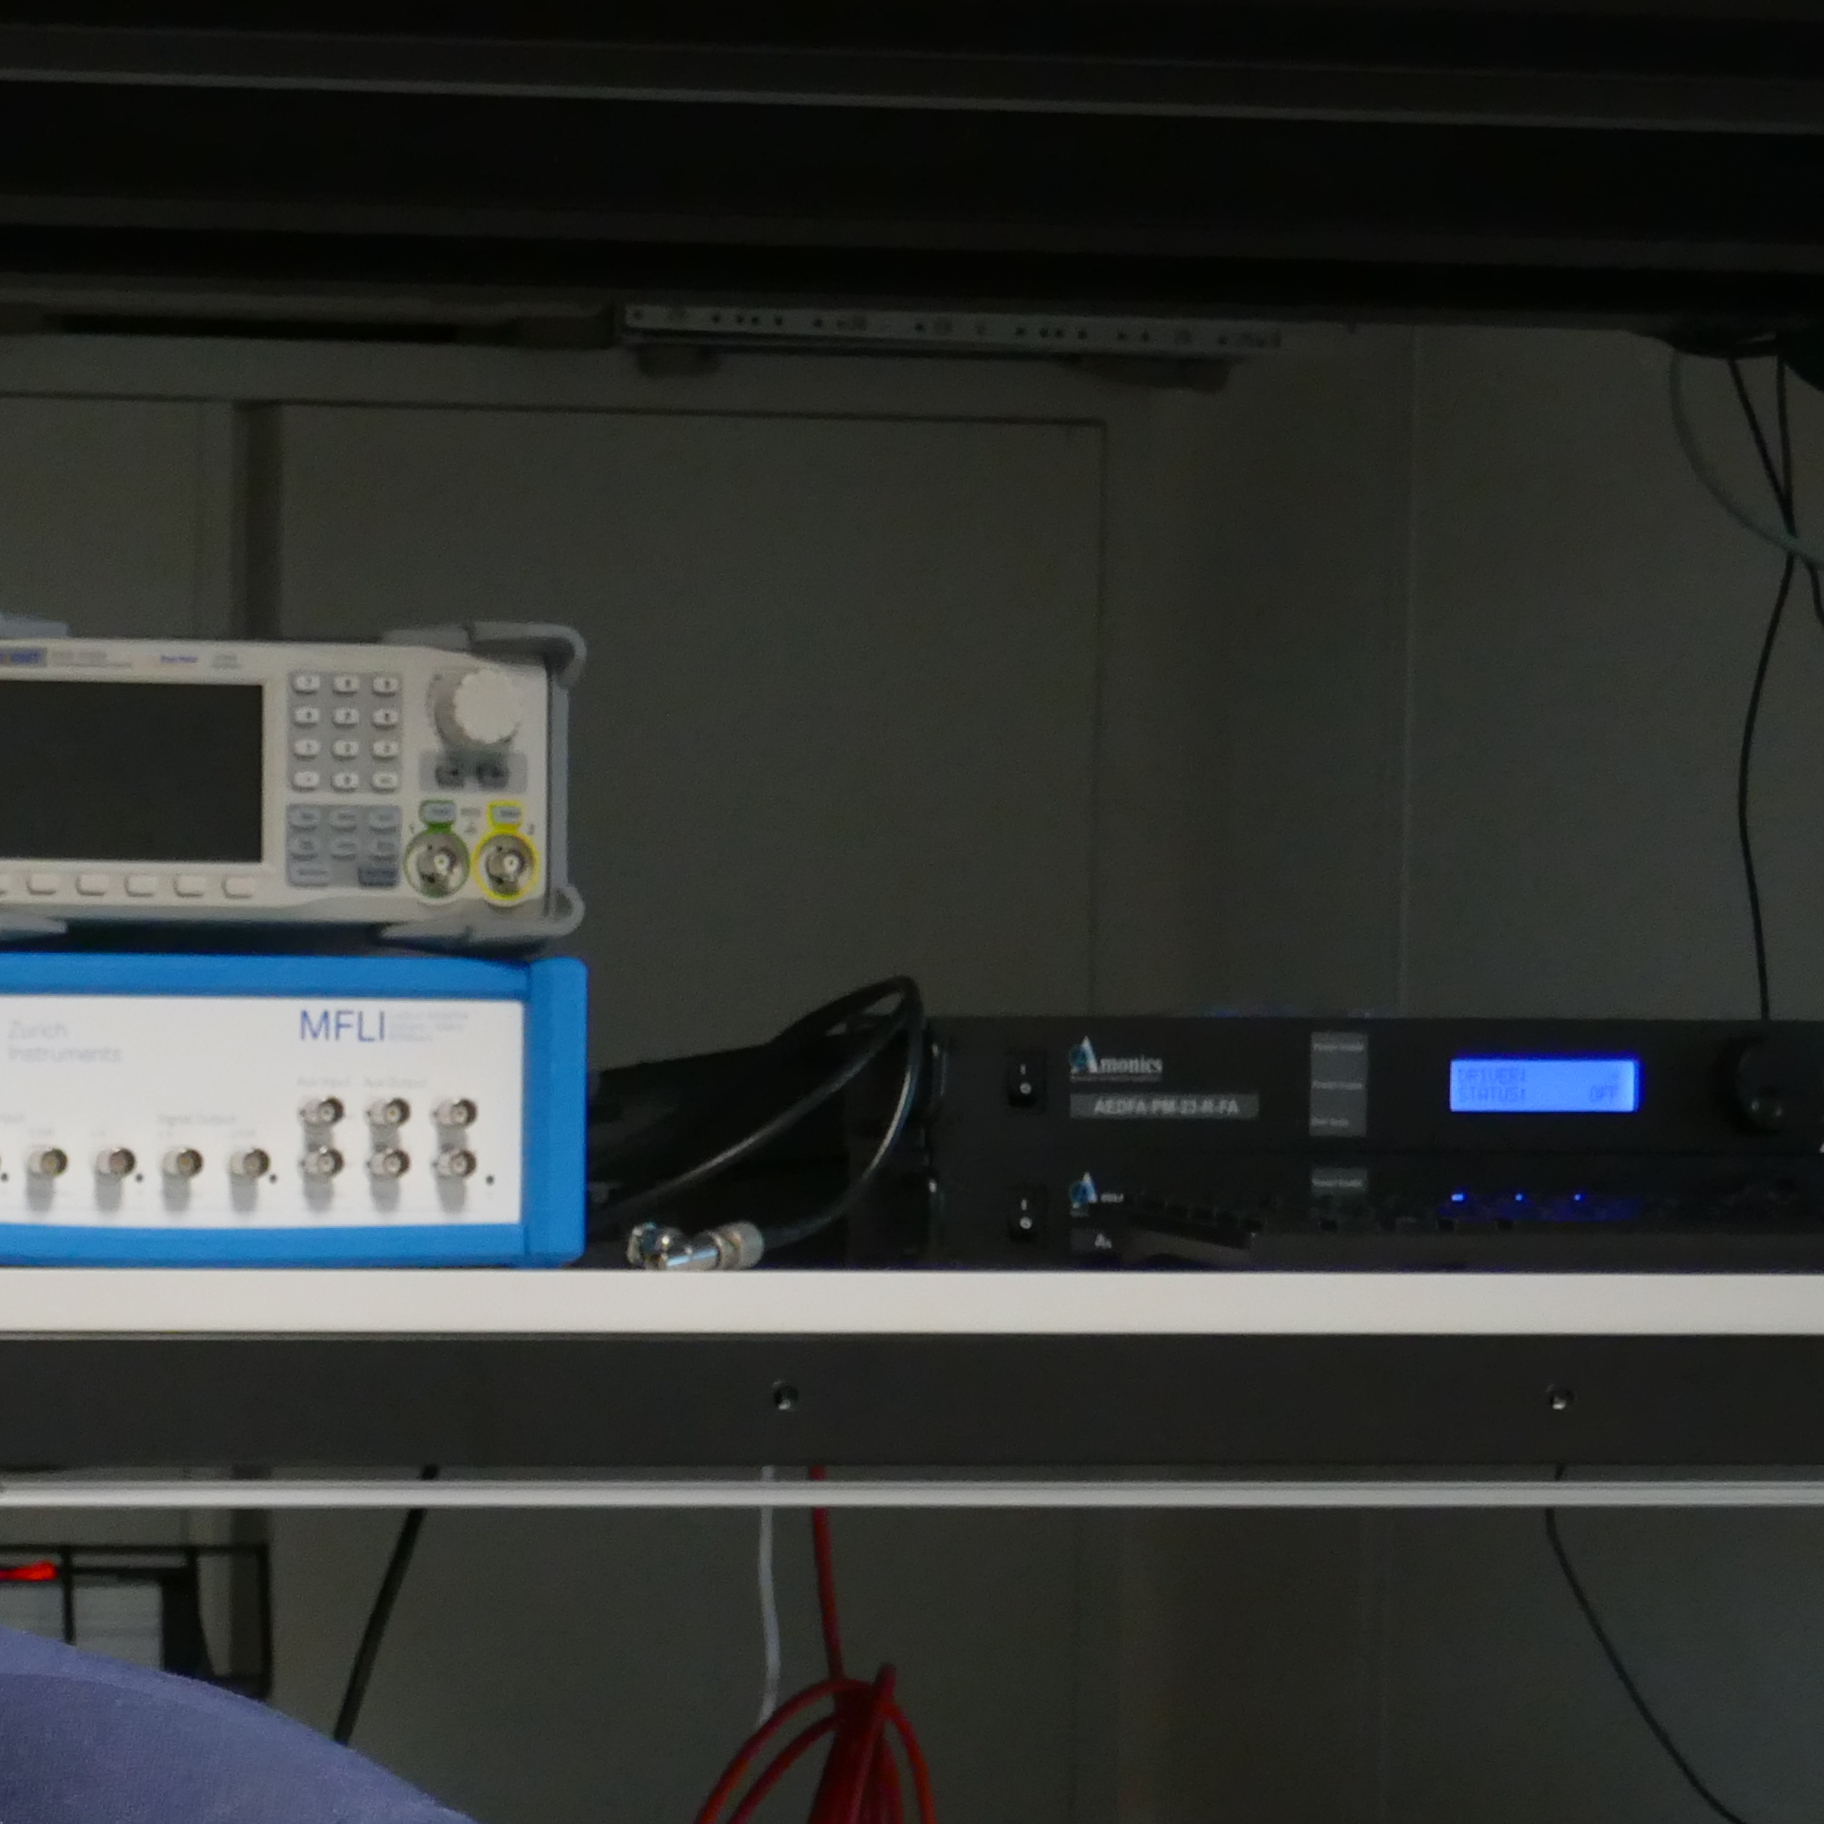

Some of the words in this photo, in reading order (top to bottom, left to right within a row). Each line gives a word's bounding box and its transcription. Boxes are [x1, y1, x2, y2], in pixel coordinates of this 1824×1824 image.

[7, 1019, 68, 1039] Zurich
[300, 1009, 386, 1043] MFLI
[7, 1046, 121, 1063] Instruments
